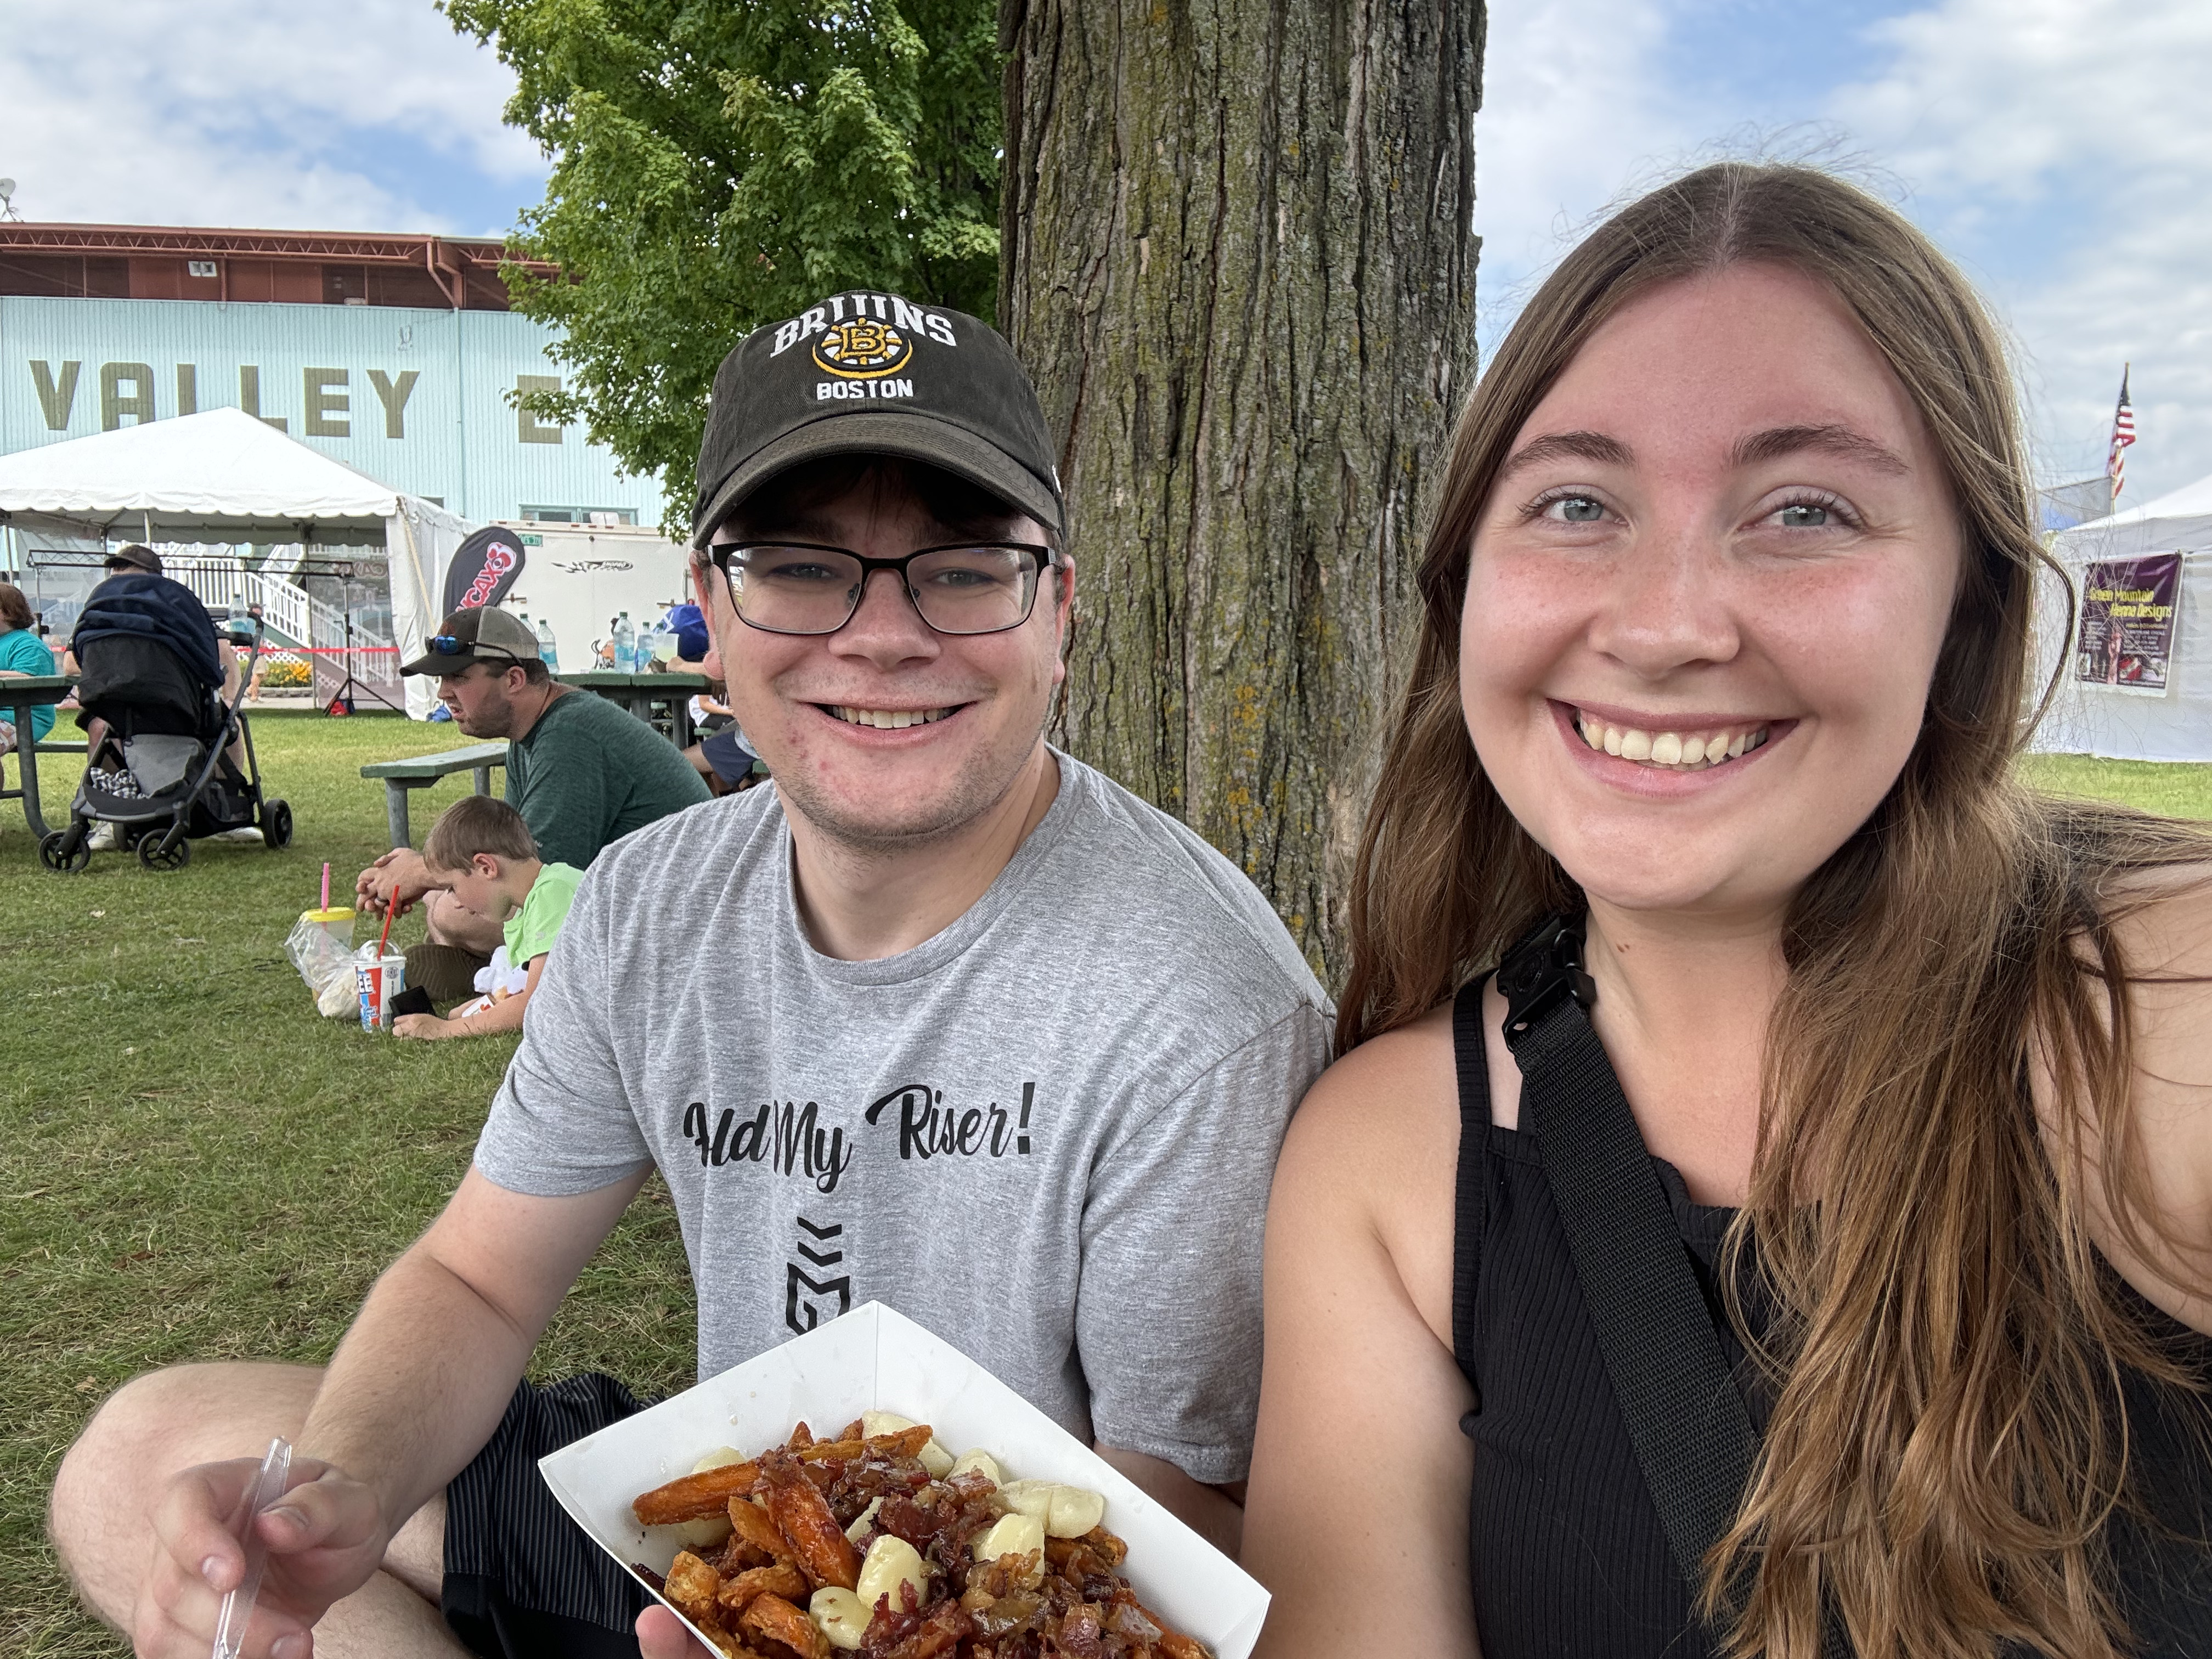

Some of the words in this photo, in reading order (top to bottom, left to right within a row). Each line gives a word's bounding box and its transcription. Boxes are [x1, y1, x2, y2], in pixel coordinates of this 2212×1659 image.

[770, 295, 957, 358] BRUINS
[29, 360, 420, 439] VALLEY
[817, 379, 913, 400] BOSTON
[2115, 588, 2154, 602] Mountain
[2137, 603, 2172, 622] Designs
[684, 1102, 771, 1167] Hld
[774, 1099, 853, 1193] My
[865, 1082, 1035, 1159] Riser!
